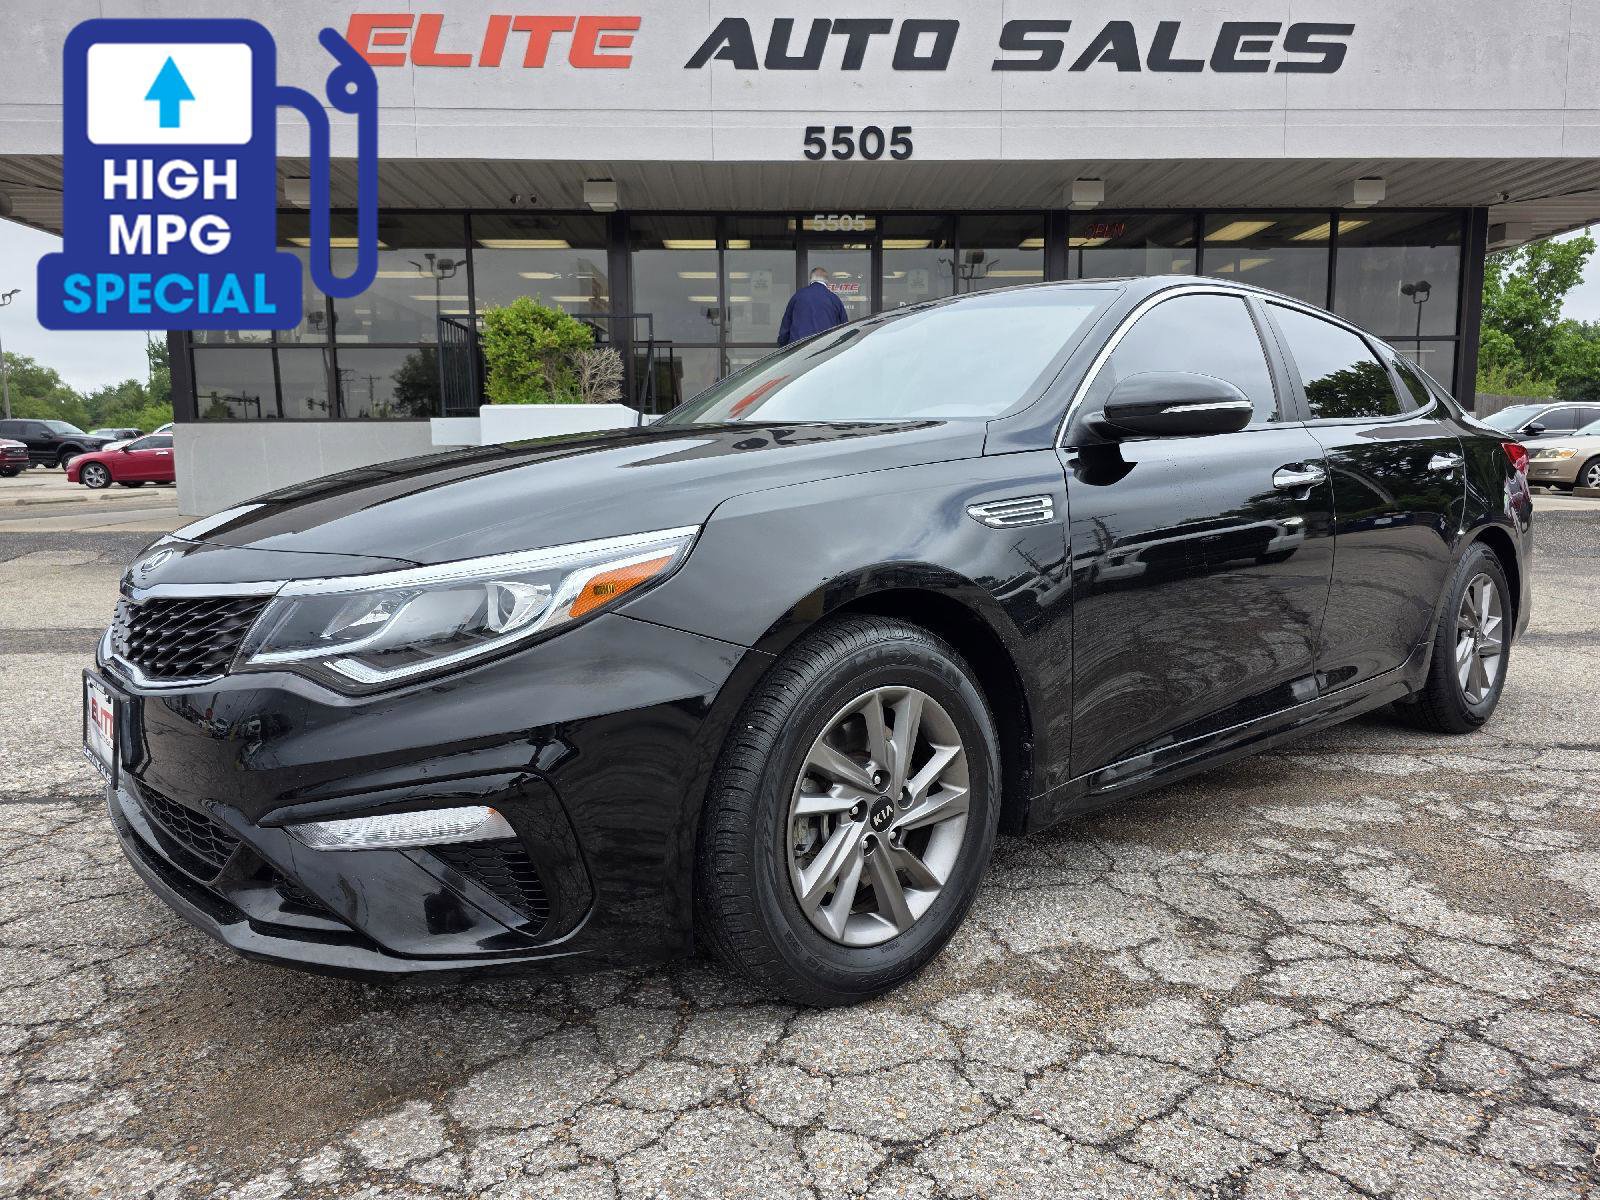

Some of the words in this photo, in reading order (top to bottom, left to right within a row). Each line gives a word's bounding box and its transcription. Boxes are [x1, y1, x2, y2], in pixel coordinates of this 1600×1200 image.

[347, 13, 641, 69] ELITE
[684, 17, 960, 71] AUTO
[991, 19, 1356, 74] SALES
[803, 125, 914, 161] 5505
[814, 214, 866, 232] 5505
[872, 804, 894, 827] KIA
